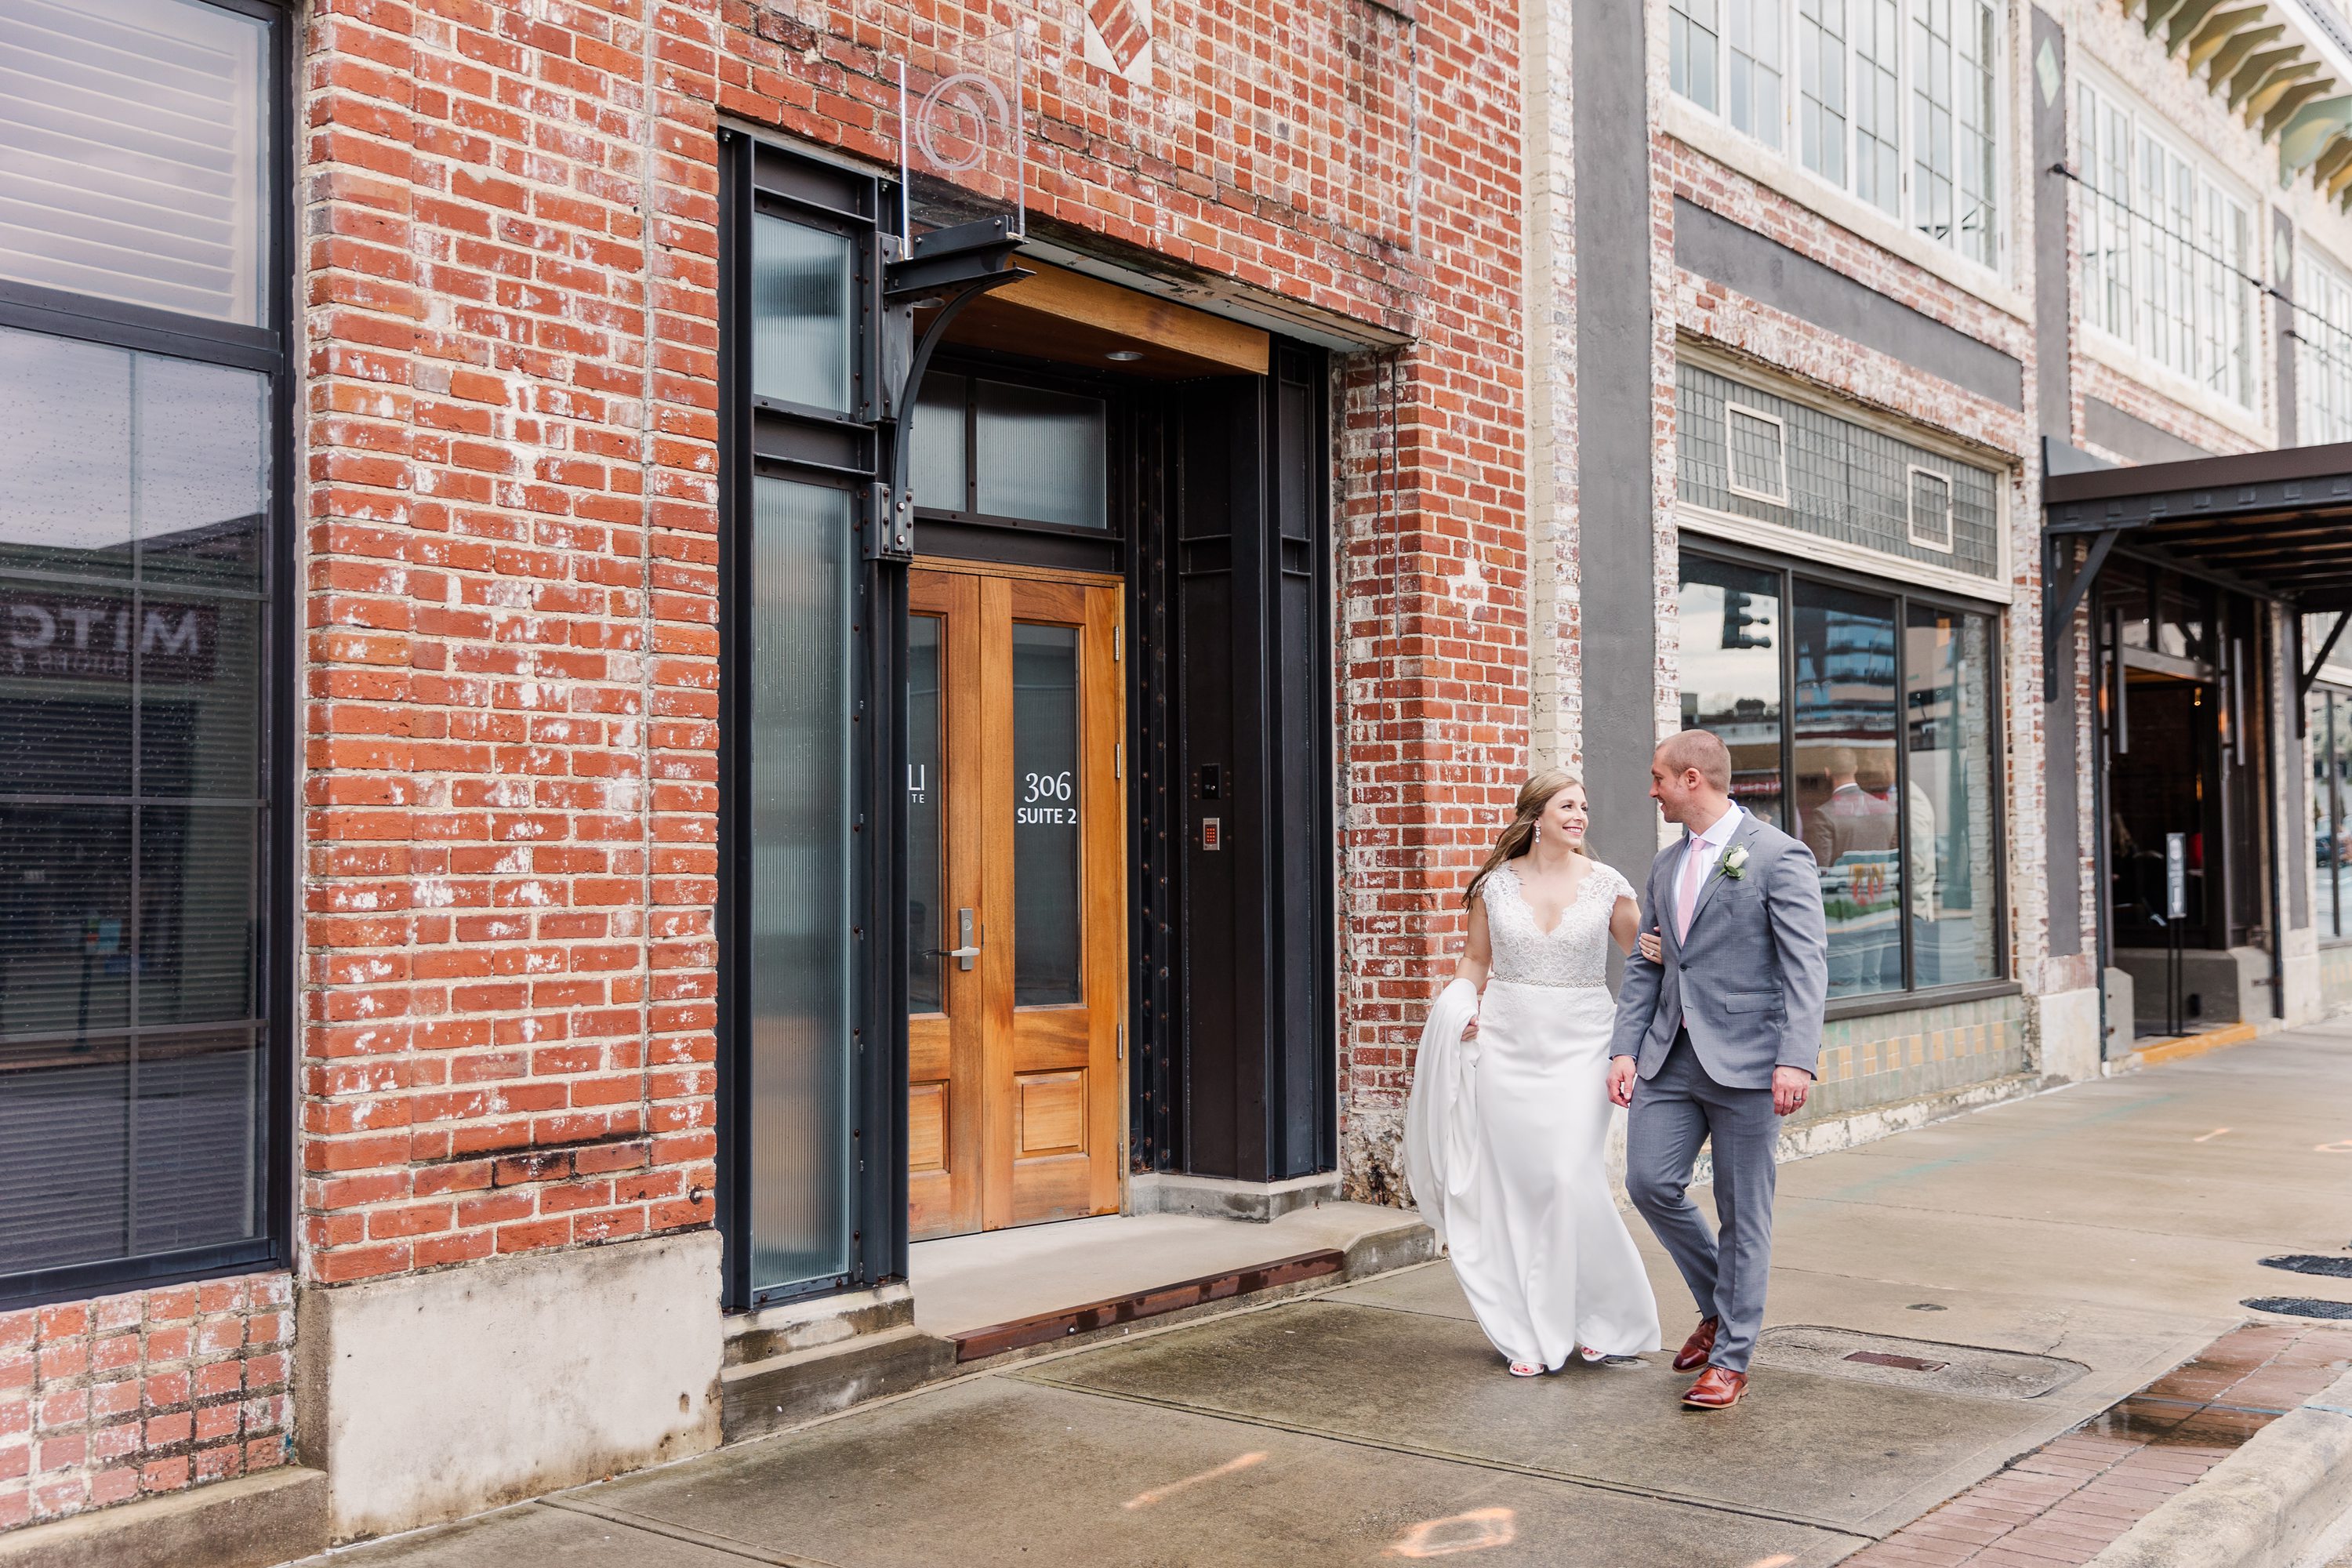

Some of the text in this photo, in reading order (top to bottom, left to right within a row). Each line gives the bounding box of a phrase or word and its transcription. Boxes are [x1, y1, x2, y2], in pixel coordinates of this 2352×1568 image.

[1024, 771, 1071, 803] 306
[1018, 808, 1076, 824] SUITE 2
